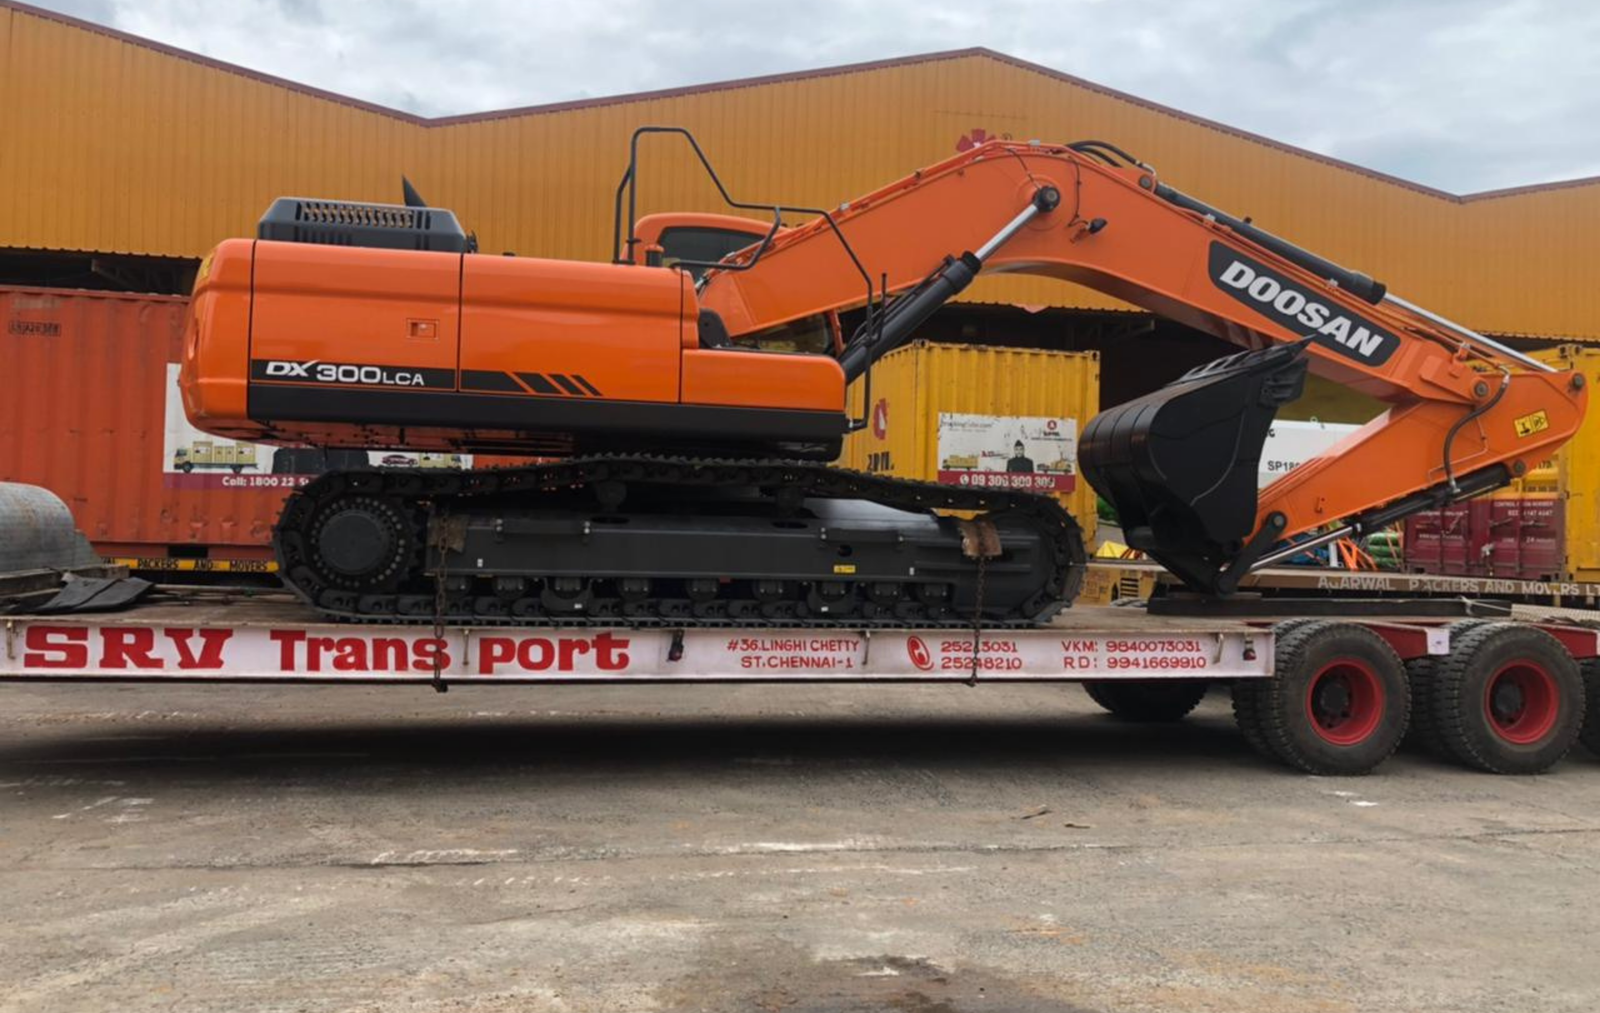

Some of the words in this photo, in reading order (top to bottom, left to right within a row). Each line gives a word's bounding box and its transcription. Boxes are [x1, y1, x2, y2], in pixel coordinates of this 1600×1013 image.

[1219, 260, 1383, 357] DOOSAN
[222, 476, 246, 486] Call:
[250, 476, 278, 487] 1800
[281, 477, 294, 487] 22
[971, 474, 985, 485] 09
[137, 559, 179, 570] PACKERS
[194, 560, 213, 570] AND
[229, 561, 267, 572] MOVERS
[1485, 581, 1514, 594] AND
[24, 625, 233, 669] SRV
[270, 629, 451, 672] Trans
[479, 632, 630, 674] port
[810, 639, 860, 652] CHETTY
[941, 641, 1018, 653] 2523031
[1062, 641, 1098, 653] VKM:
[1106, 641, 1201, 652] 9840073031
[1107, 656, 1206, 669] 9941669910
